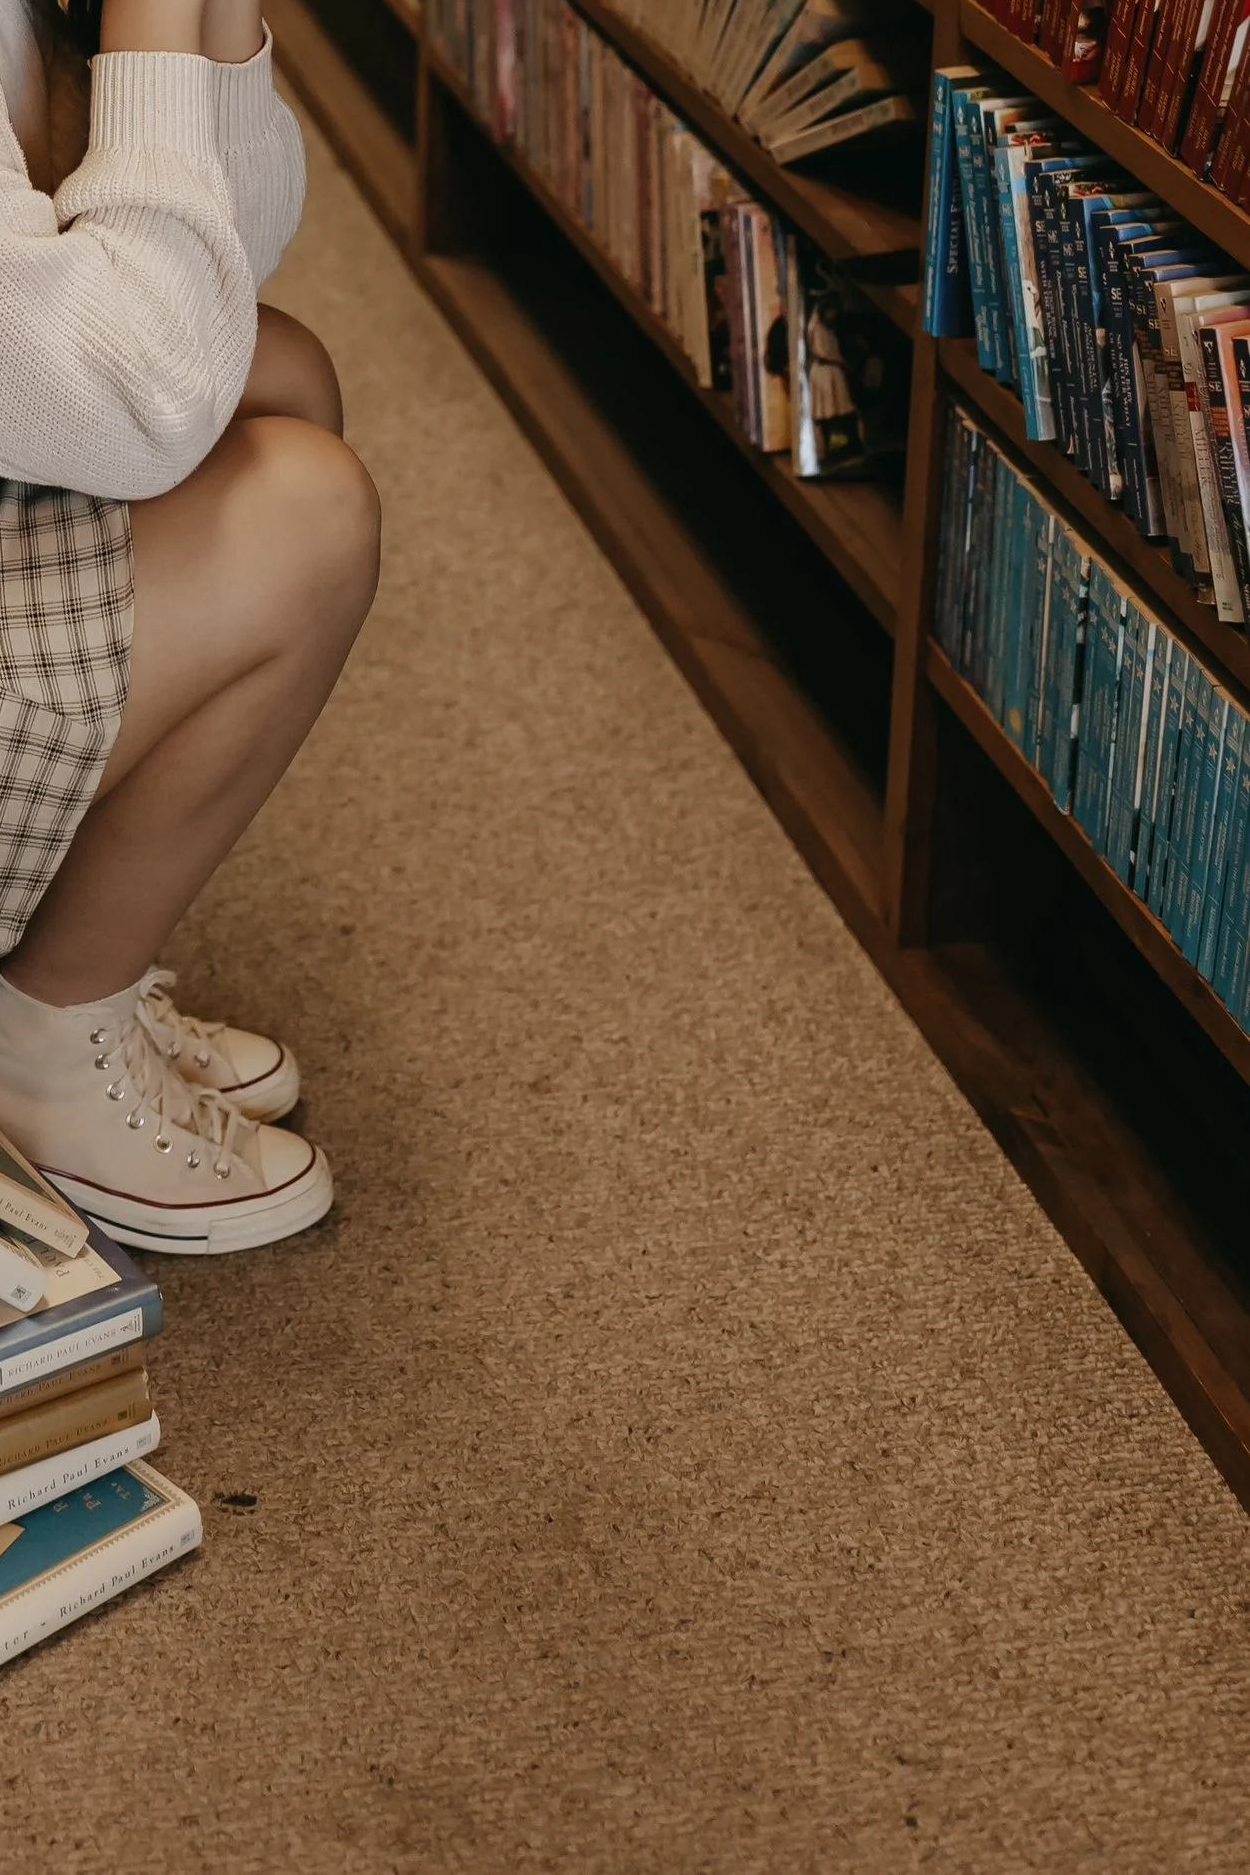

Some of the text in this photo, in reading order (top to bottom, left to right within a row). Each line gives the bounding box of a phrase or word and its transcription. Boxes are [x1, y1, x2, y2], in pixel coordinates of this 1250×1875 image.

[946, 221, 960, 274] SPECIAL
[4, 1198, 24, 1219] Paul
[26, 1209, 48, 1231] Evans
[8, 1329, 116, 1377] RICHARD PAUL EVANS
[38, 1377, 62, 1392] PAUL
[46, 1434, 70, 1449] PAUL
[6, 1478, 56, 1511] Richard
[61, 1460, 90, 1485] Paul
[94, 1445, 130, 1469] Evans
[58, 1543, 176, 1619] Richard Paul Evans
